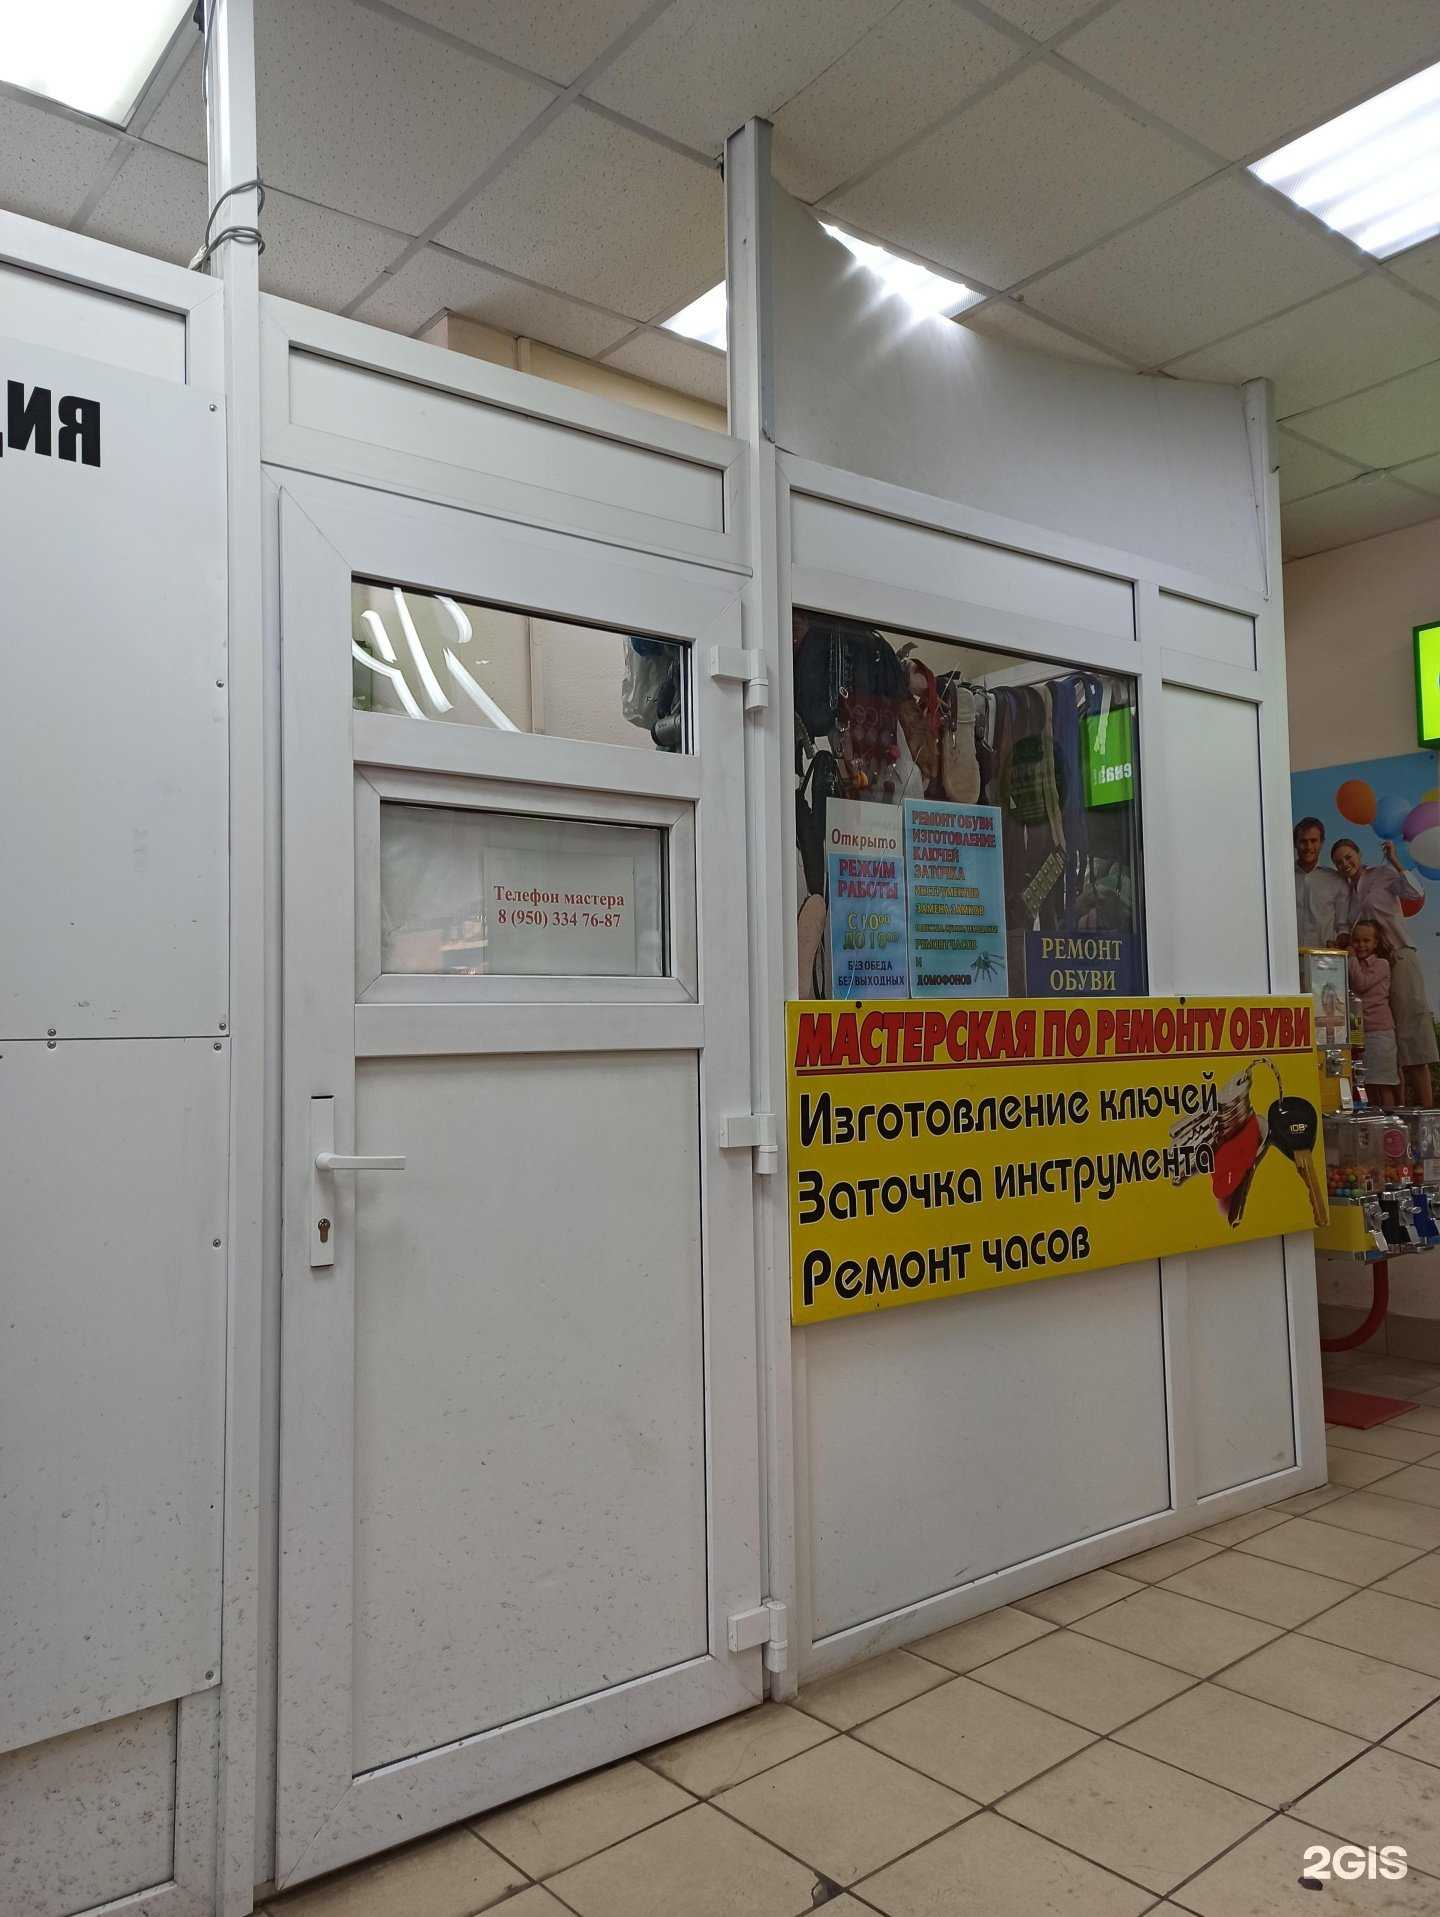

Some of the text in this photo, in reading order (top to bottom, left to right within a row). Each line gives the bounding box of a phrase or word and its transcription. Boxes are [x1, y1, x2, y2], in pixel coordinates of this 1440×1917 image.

[0, 379, 101, 468] ИЯ
[912, 810, 994, 832] РЕМОНТ ОБУВИ
[831, 828, 897, 850] Открыто
[912, 828, 997, 849] ИЗГОТОВЛЕНИЕ
[913, 846, 960, 863] КЛЮЧЕЙ
[839, 859, 896, 880] РЕЖИМ
[494, 885, 625, 909] Телефон мастера
[838, 880, 899, 900] РАБОТЫ
[498, 909, 621, 928] 8 (950) 334 76-87
[843, 930, 866, 950] ДО
[1041, 937, 1122, 961] РЕМОНТ
[848, 961, 893, 971] БЕЗ ОБЕДА
[838, 976, 905, 986] БЕЗ ВЫХОДНЫХ
[917, 974, 972, 986] ДОМОФОНОВ
[1050, 969, 1116, 991] ОБУВИ
[795, 1007, 1311, 1068] МАСТЕРСКАЯ ПО РЕМОНТУ ОБУВИ
[799, 1071, 1219, 1148] Изготовление ключей
[797, 1143, 1216, 1225] Заточка инструмента
[803, 1225, 1092, 1306] Ремонт часов
